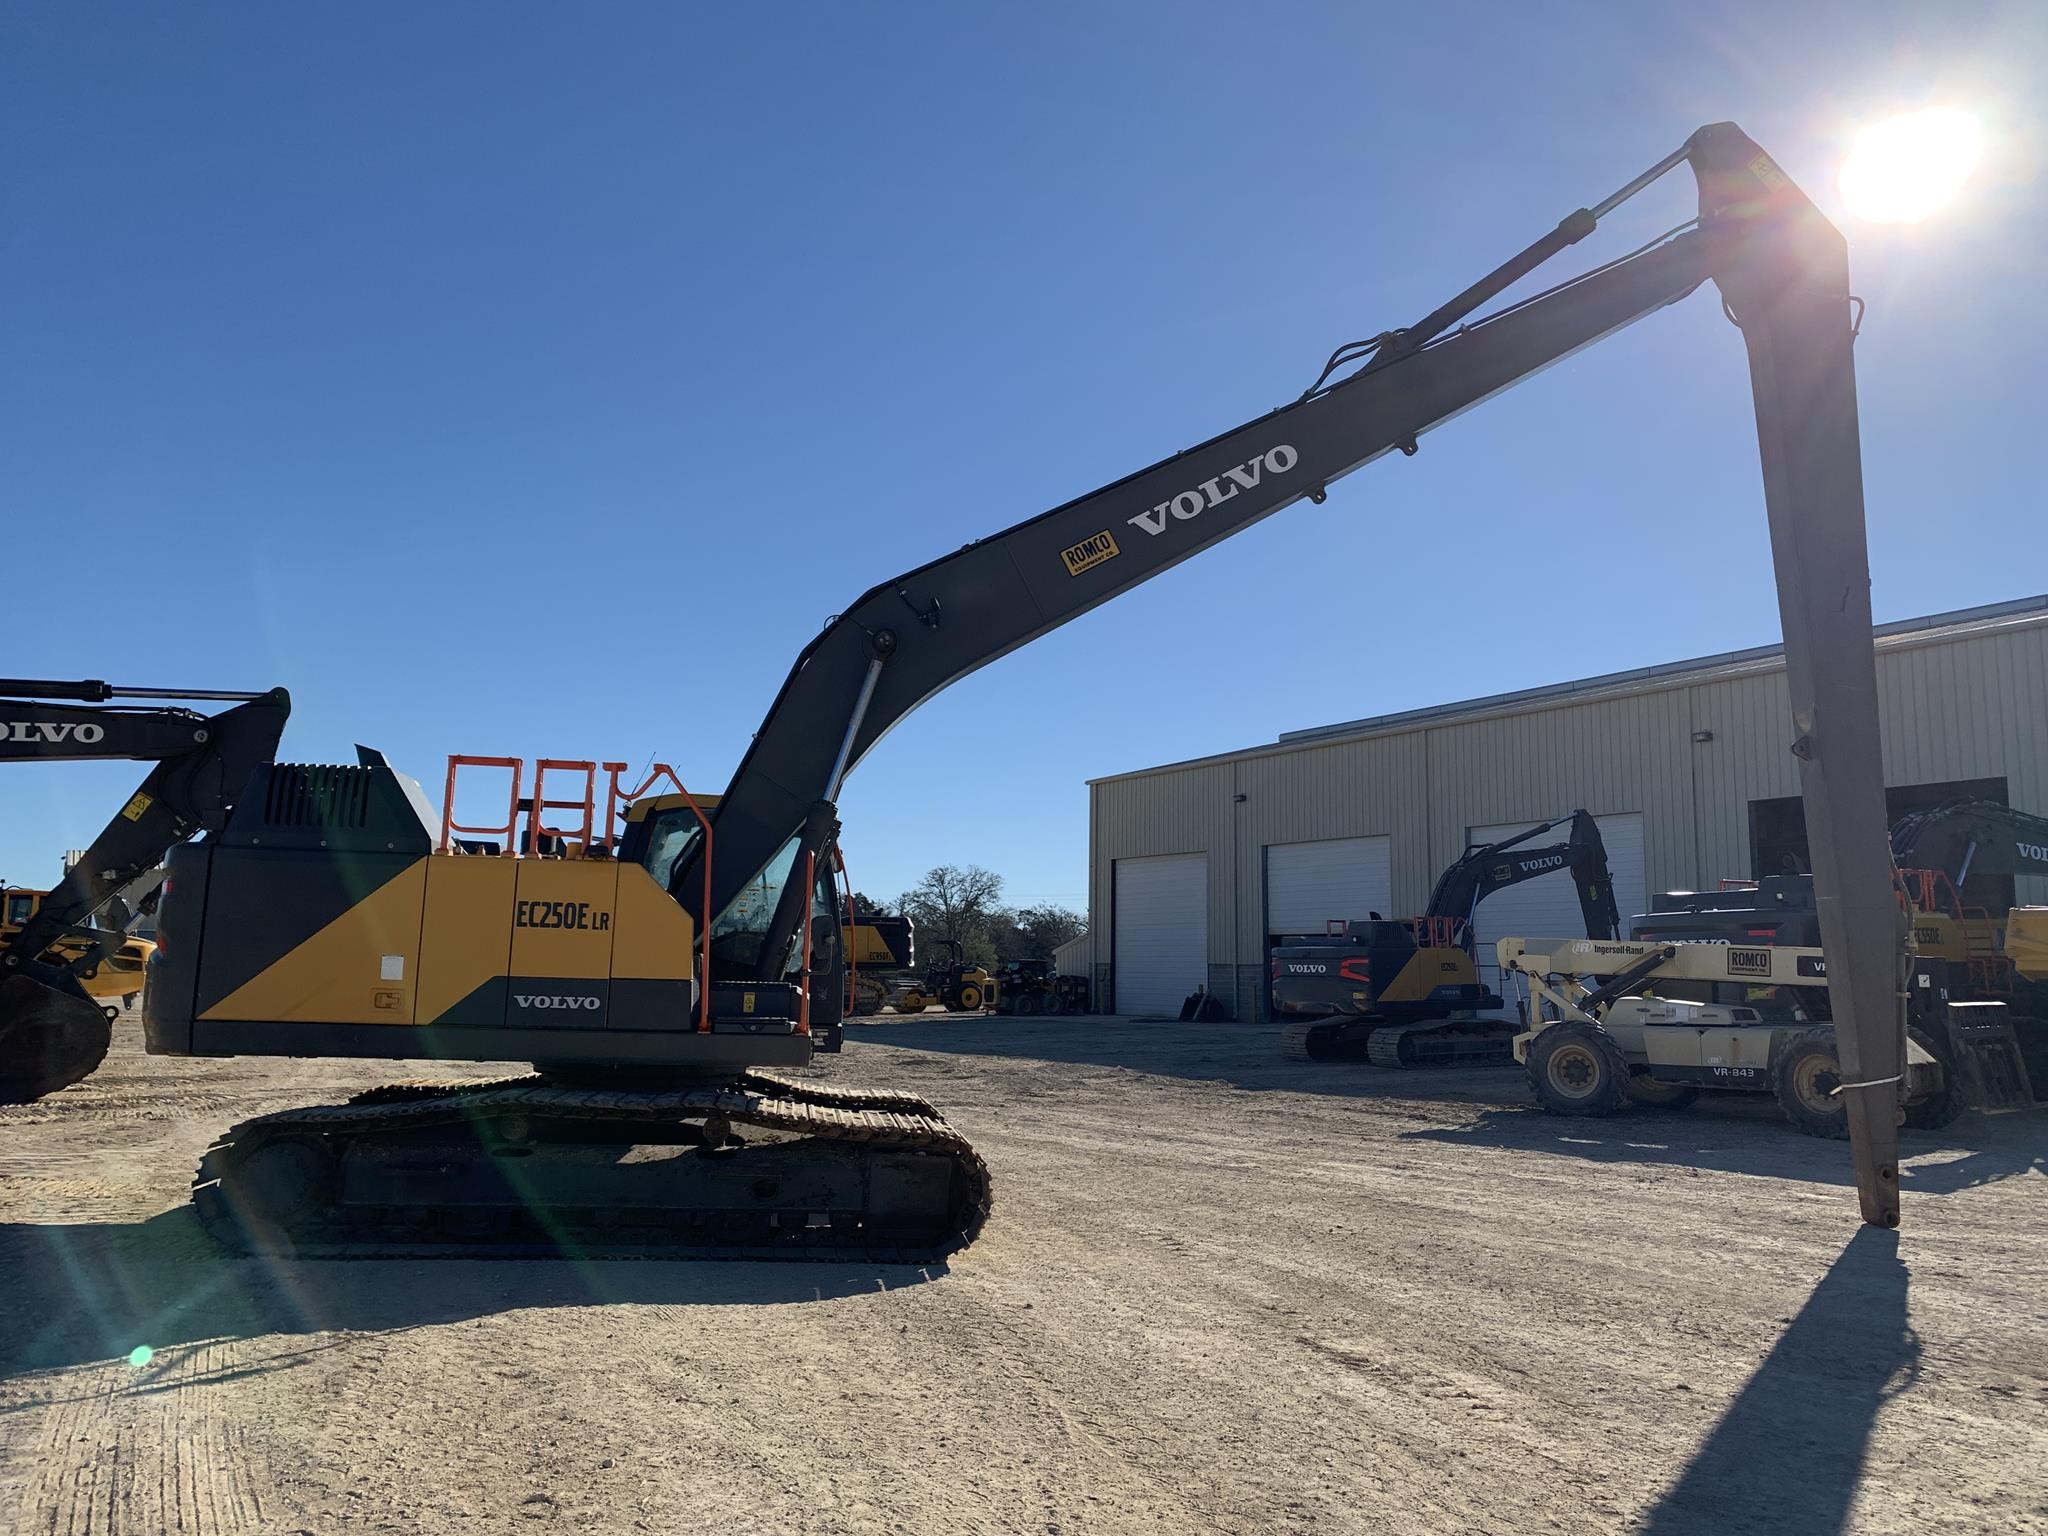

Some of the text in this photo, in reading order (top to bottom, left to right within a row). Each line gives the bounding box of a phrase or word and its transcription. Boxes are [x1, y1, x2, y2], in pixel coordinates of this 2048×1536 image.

[1127, 444, 1298, 536] VOLVO
[1066, 534, 1111, 566] ROMCO
[1074, 554, 1105, 573] EQUIPMENT
[0, 722, 104, 743] LVO
[1519, 855, 1563, 872] VOLVO
[516, 900, 609, 930] EC250E LR
[1594, 944, 1644, 955] Ingersoll-Rand
[1731, 951, 1767, 967] ROMCO
[1288, 964, 1327, 973] VOLVO
[513, 995, 600, 1010] VOLVO
[1713, 1067, 1755, 1077] VR-843
